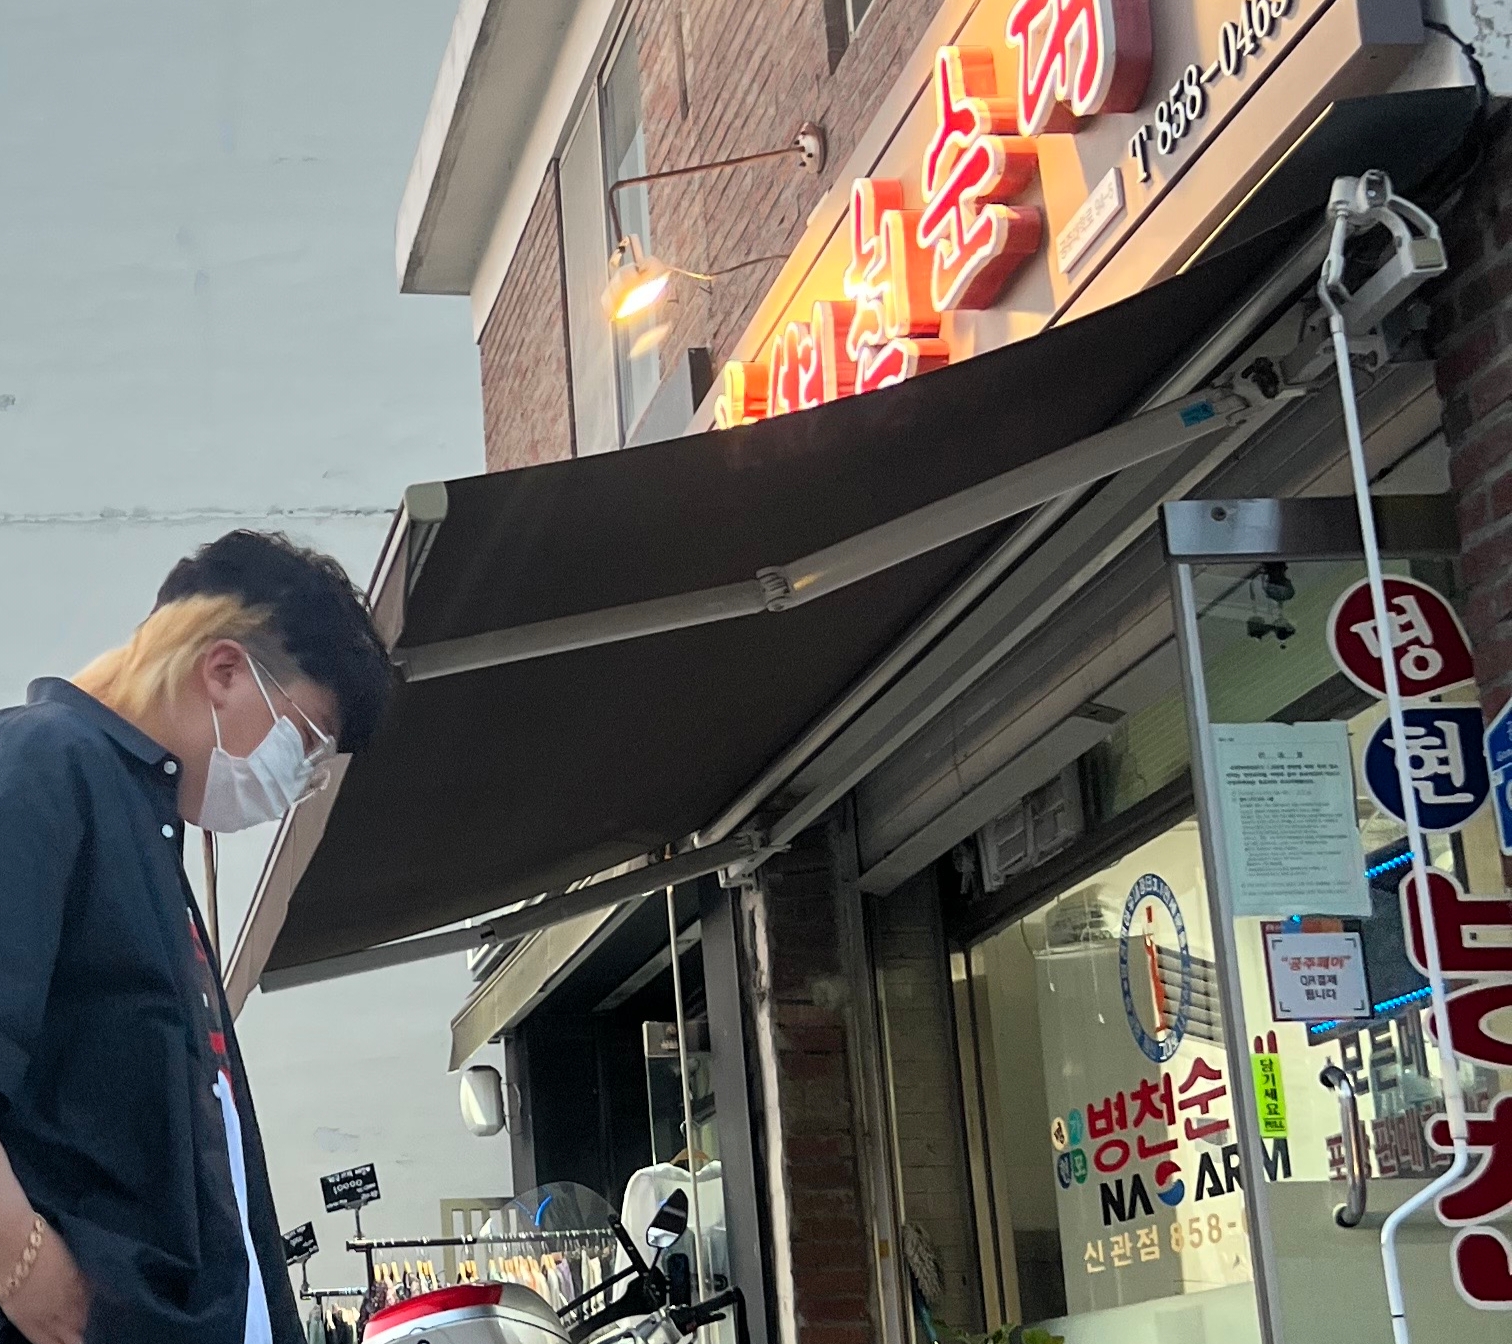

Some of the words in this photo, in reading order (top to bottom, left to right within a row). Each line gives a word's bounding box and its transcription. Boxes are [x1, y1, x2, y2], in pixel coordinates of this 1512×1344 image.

[1128, 125, 1151, 183] T
[1350, 595, 1443, 680] 명
[1383, 721, 1474, 804] 현
[1084, 1224, 1161, 1273] 신관점
